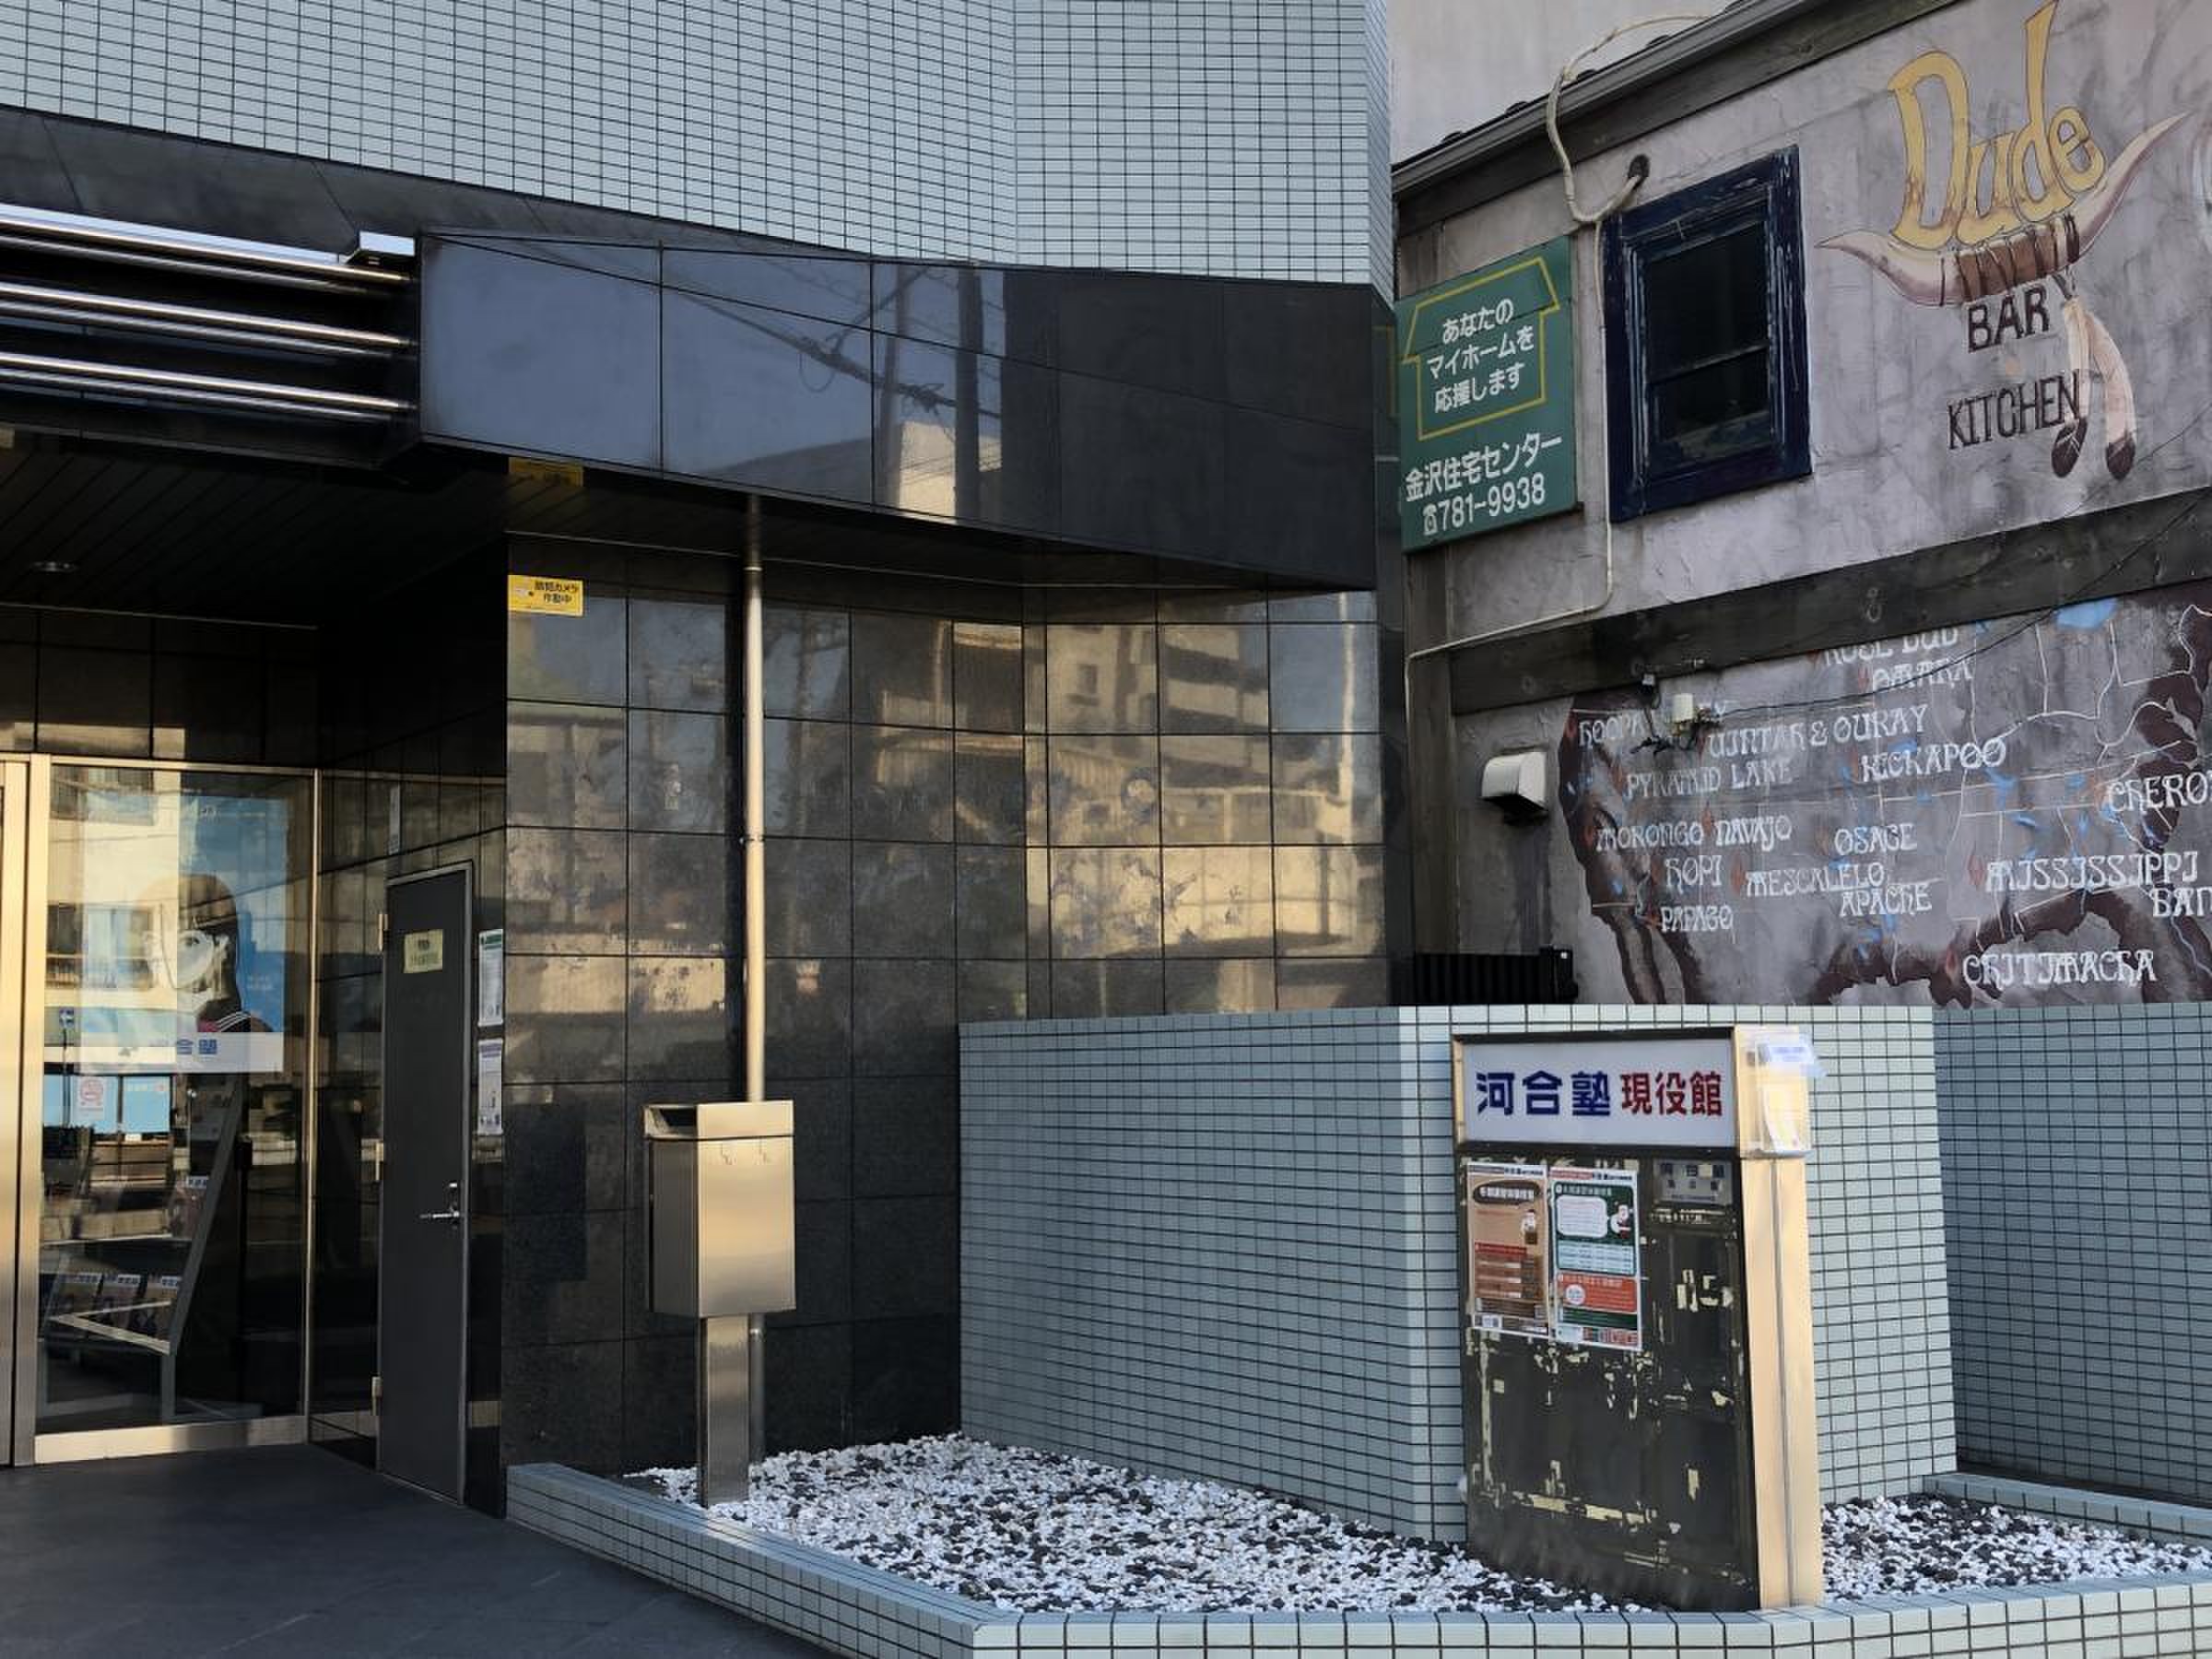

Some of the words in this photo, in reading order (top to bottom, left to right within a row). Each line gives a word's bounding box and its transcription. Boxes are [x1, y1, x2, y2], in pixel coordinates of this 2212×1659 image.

[1887, 0, 2106, 251] Dude
[1442, 298, 1514, 344] あなたの
[1968, 286, 2050, 354] BAR
[1427, 325, 1535, 380] マイホームを
[1435, 361, 1525, 413] 応援します
[1947, 371, 2080, 450] KITCHEN
[1405, 432, 1562, 501] 金沢住宅センター
[1811, 721, 1830, 747] &
[1833, 703, 1928, 744] OURAY
[1730, 758, 1793, 790] LAKE
[2108, 771, 2212, 816] CHERO
[1664, 853, 1723, 894] HOPI
[1839, 882, 1933, 918] APACHE
[1476, 1070, 1611, 1117] 河合塾
[1619, 1071, 1724, 1117] 現役館
